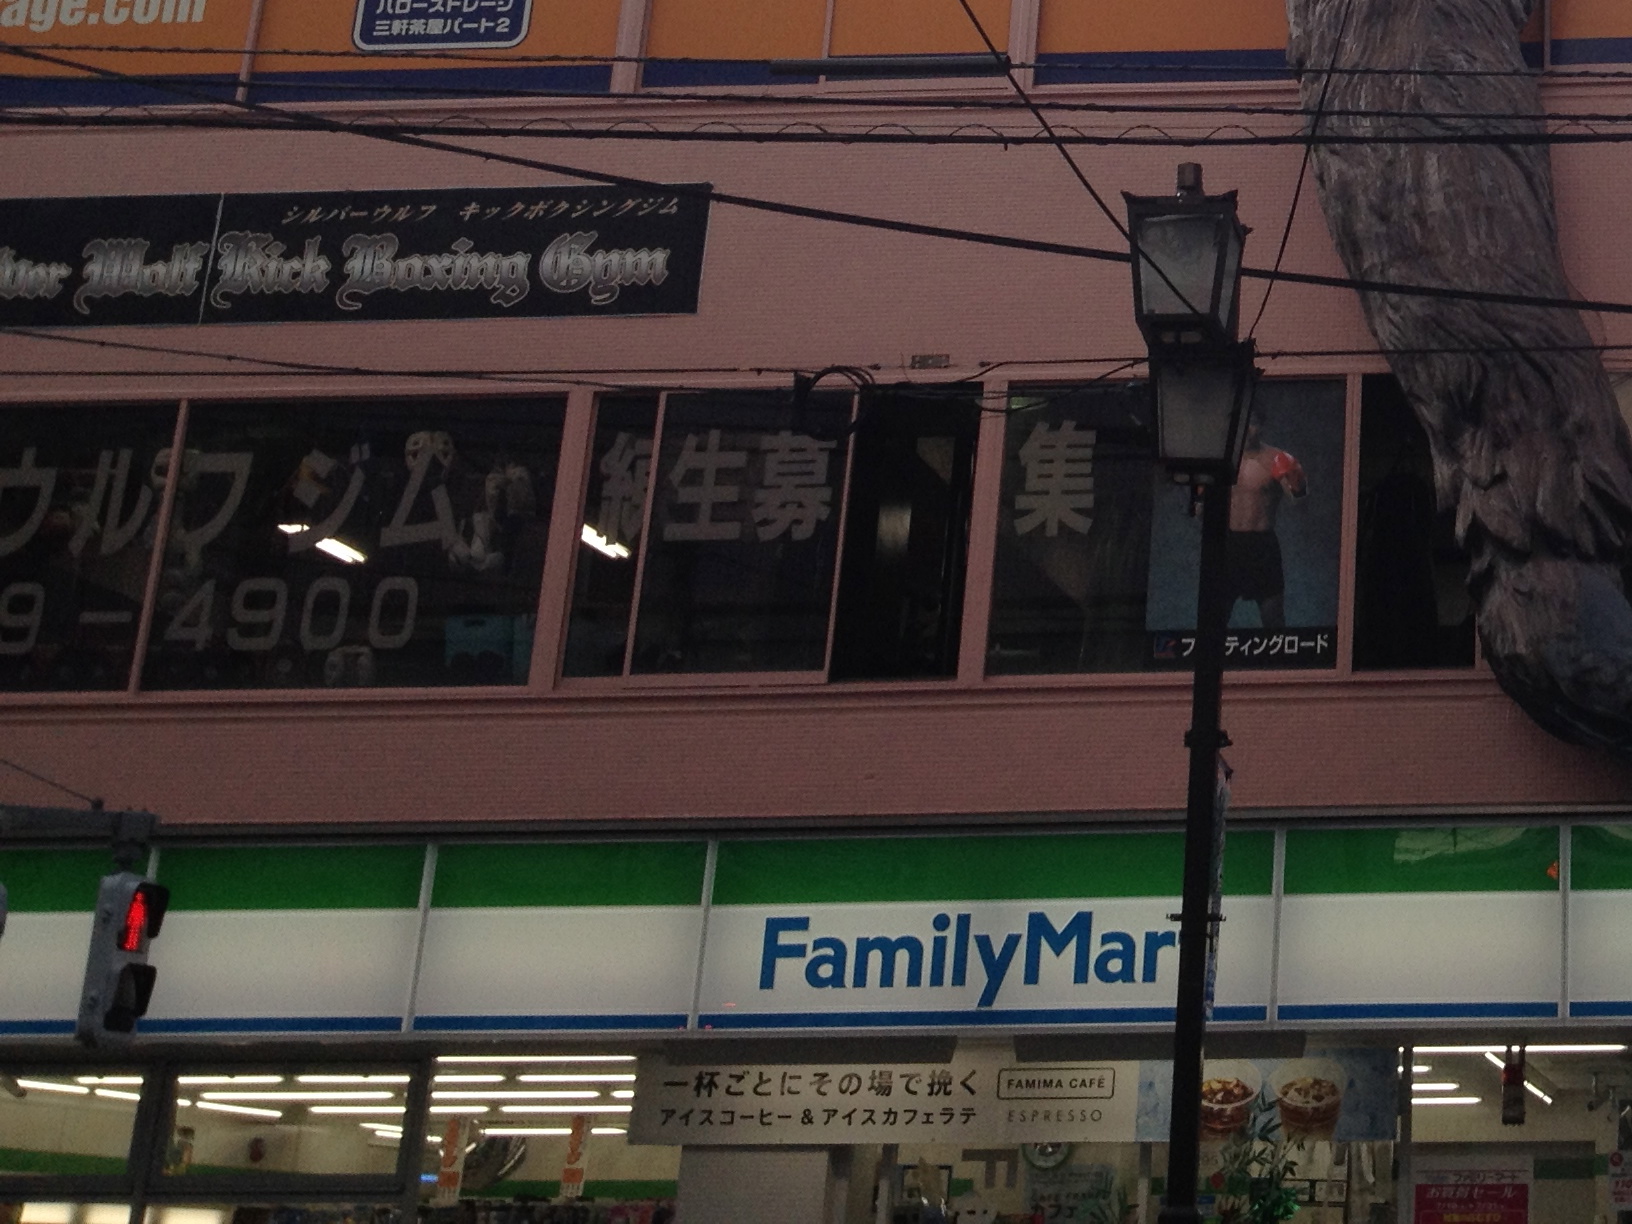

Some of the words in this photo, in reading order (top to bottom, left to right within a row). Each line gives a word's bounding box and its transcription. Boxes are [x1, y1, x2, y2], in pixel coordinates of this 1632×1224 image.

[372, 16, 512, 37] 三軒茶屋パート2
[281, 203, 438, 225] シルバーウルフ
[458, 196, 681, 221] キックボクシングジム
[73, 237, 210, 315] Wolf
[210, 231, 331, 309] Kick
[336, 231, 531, 309] Boxing
[538, 230, 670, 305] Gym
[1014, 419, 1097, 538] 集
[1180, 633, 1329, 658] フティングロード
[759, 911, 1182, 1009] FamilyMar
[663, 1068, 978, 1099] 一杯ごとにその場で挽く
[1006, 1078, 1064, 1090] FAMIMA
[1007, 1109, 1103, 1123] ESPRESSO
